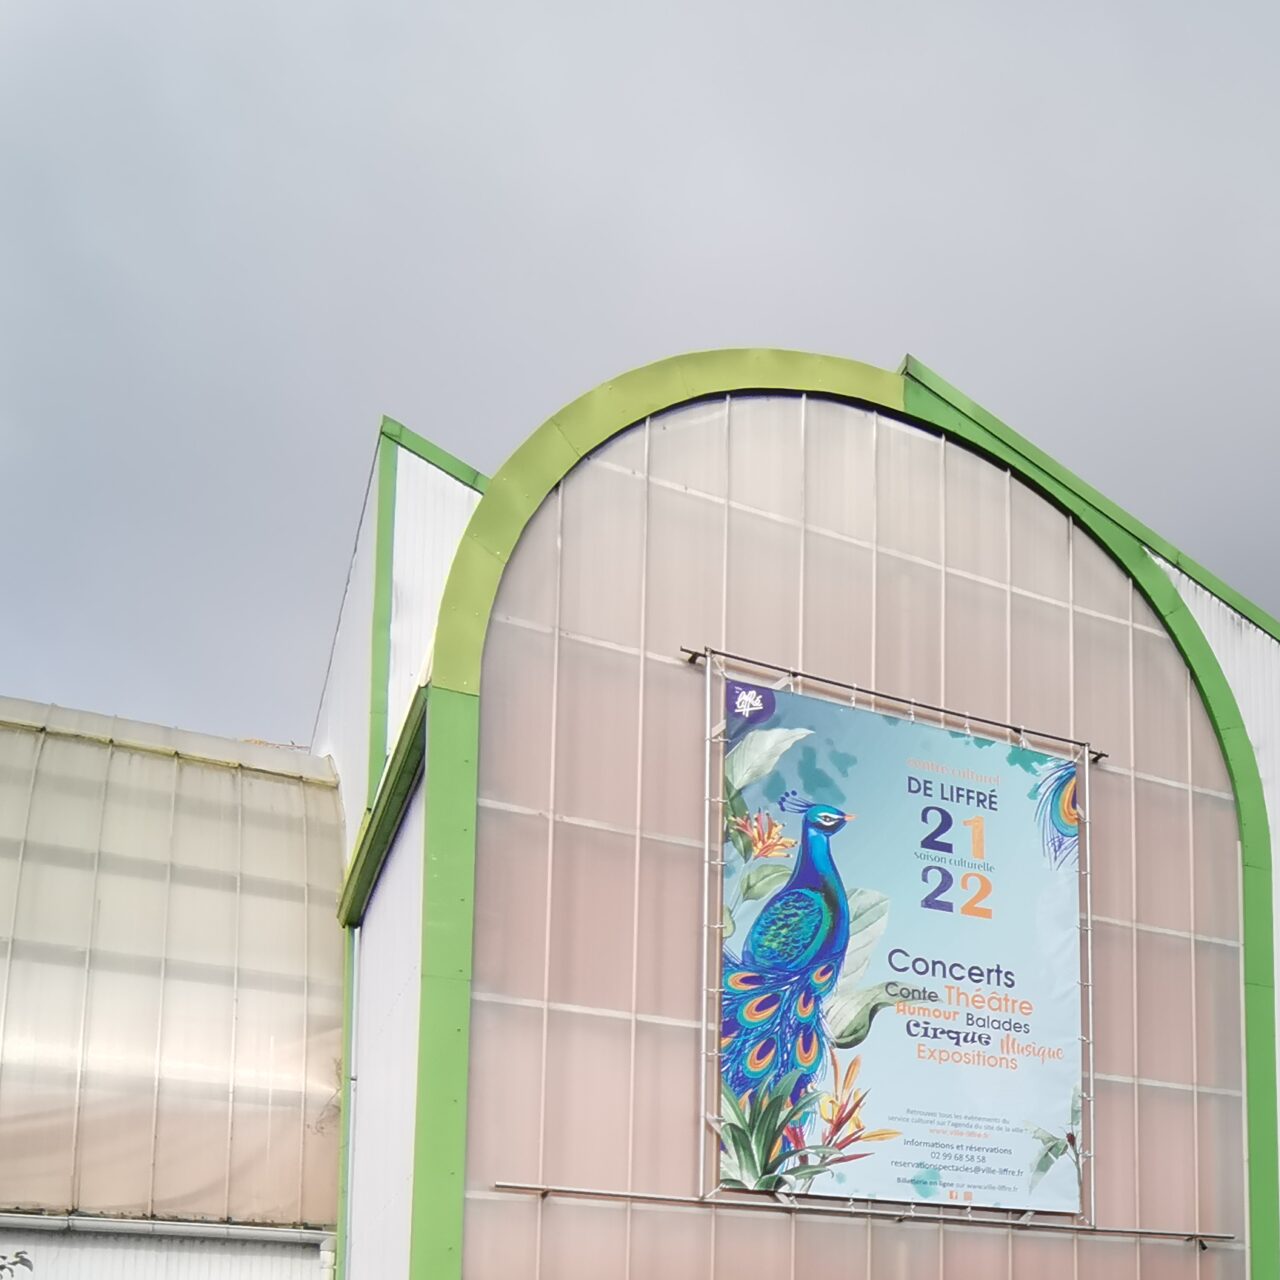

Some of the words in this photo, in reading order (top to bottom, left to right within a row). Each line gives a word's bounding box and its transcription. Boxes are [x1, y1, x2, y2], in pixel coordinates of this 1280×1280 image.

[907, 775, 934, 798] DE
[940, 782, 998, 812] LIFFRÉ
[913, 851, 947, 865] saison
[949, 857, 996, 873] culturelle
[920, 865, 993, 919] 22
[887, 948, 1016, 989] Concerts
[885, 981, 939, 1003] Conte
[944, 984, 1033, 1016] Théâtre
[966, 1012, 1031, 1035] Balades
[905, 1018, 992, 1047] Cirque
[1000, 1033, 1065, 1065] Musique
[916, 1043, 1019, 1071] Expositions
[903, 1138, 955, 1150] Informations
[956, 1143, 964, 1151] et
[965, 1144, 1013, 1155] réservations
[930, 1151, 941, 1160] 02
[942, 1152, 953, 1161] 99
[953, 1153, 964, 1162] 68
[965, 1154, 975, 1163] 58
[976, 1155, 987, 1164] 58
